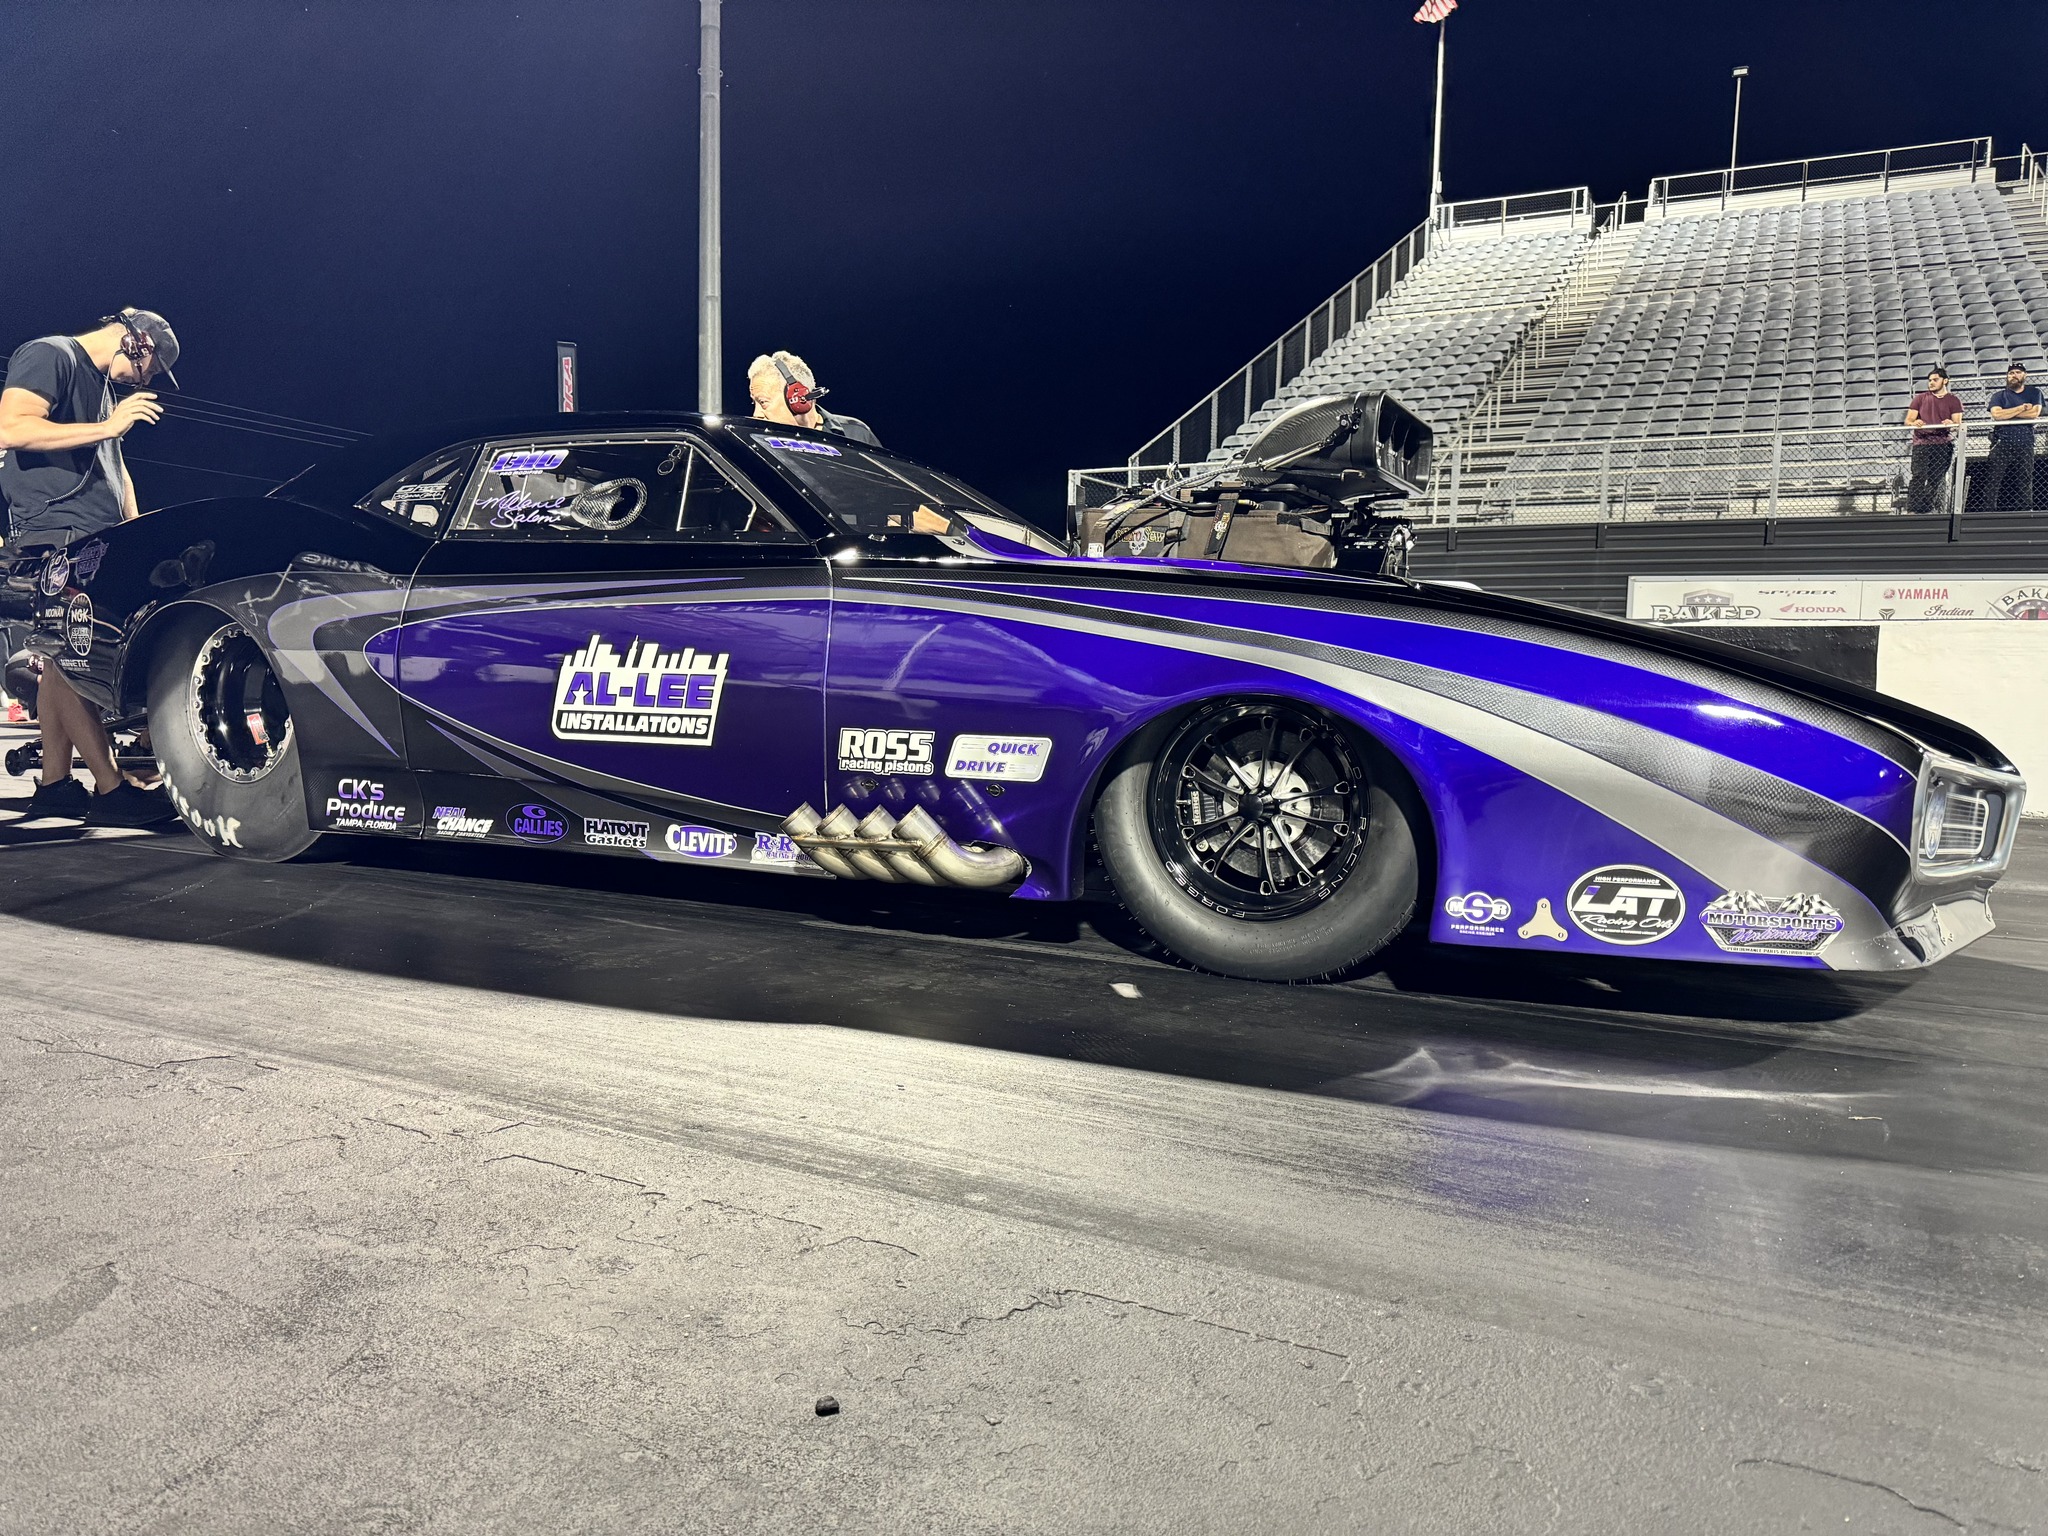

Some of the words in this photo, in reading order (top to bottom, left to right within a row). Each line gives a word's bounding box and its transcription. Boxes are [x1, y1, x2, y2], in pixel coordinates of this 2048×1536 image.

[764, 437, 842, 456] 1310
[489, 450, 569, 473] 1310
[1898, 588, 1949, 600] YAMAHA
[45, 608, 64, 618] NOONAN
[71, 608, 89, 623] NGK
[1651, 605, 1761, 620] BAKED
[1924, 604, 1974, 616] Indian
[563, 672, 717, 709] AL-LEE
[560, 712, 709, 735] INSTALLATIONS
[840, 729, 934, 762] ROSS
[988, 742, 1039, 756] QUICK
[841, 758, 882, 773] racing
[884, 760, 932, 775] pistons
[955, 759, 1006, 773] DRIVE
[338, 778, 385, 801] CK's
[326, 798, 406, 822] Produce
[432, 806, 467, 820] NEAL
[336, 817, 364, 828] TAMPA,
[365, 820, 397, 831] FLORIDA
[437, 817, 493, 833] CHANCE
[514, 817, 564, 837] CALLIES
[585, 819, 649, 837] FLATOUT
[586, 834, 647, 848] Gaskets
[666, 824, 734, 854] CLEVITE
[757, 833, 795, 852] R&R
[1318, 816, 1367, 899] RACING
[1165, 861, 1246, 918] FORGED
[1446, 892, 1511, 924] MSR
[1572, 885, 1679, 917] LAT
[1450, 924, 1504, 933] PERFORMANCE
[1580, 914, 1638, 930] Racing
[1639, 917, 1674, 929] Oils
[1707, 912, 1837, 931] MOTORSPORTS
[1729, 927, 1820, 944] Unlimited
